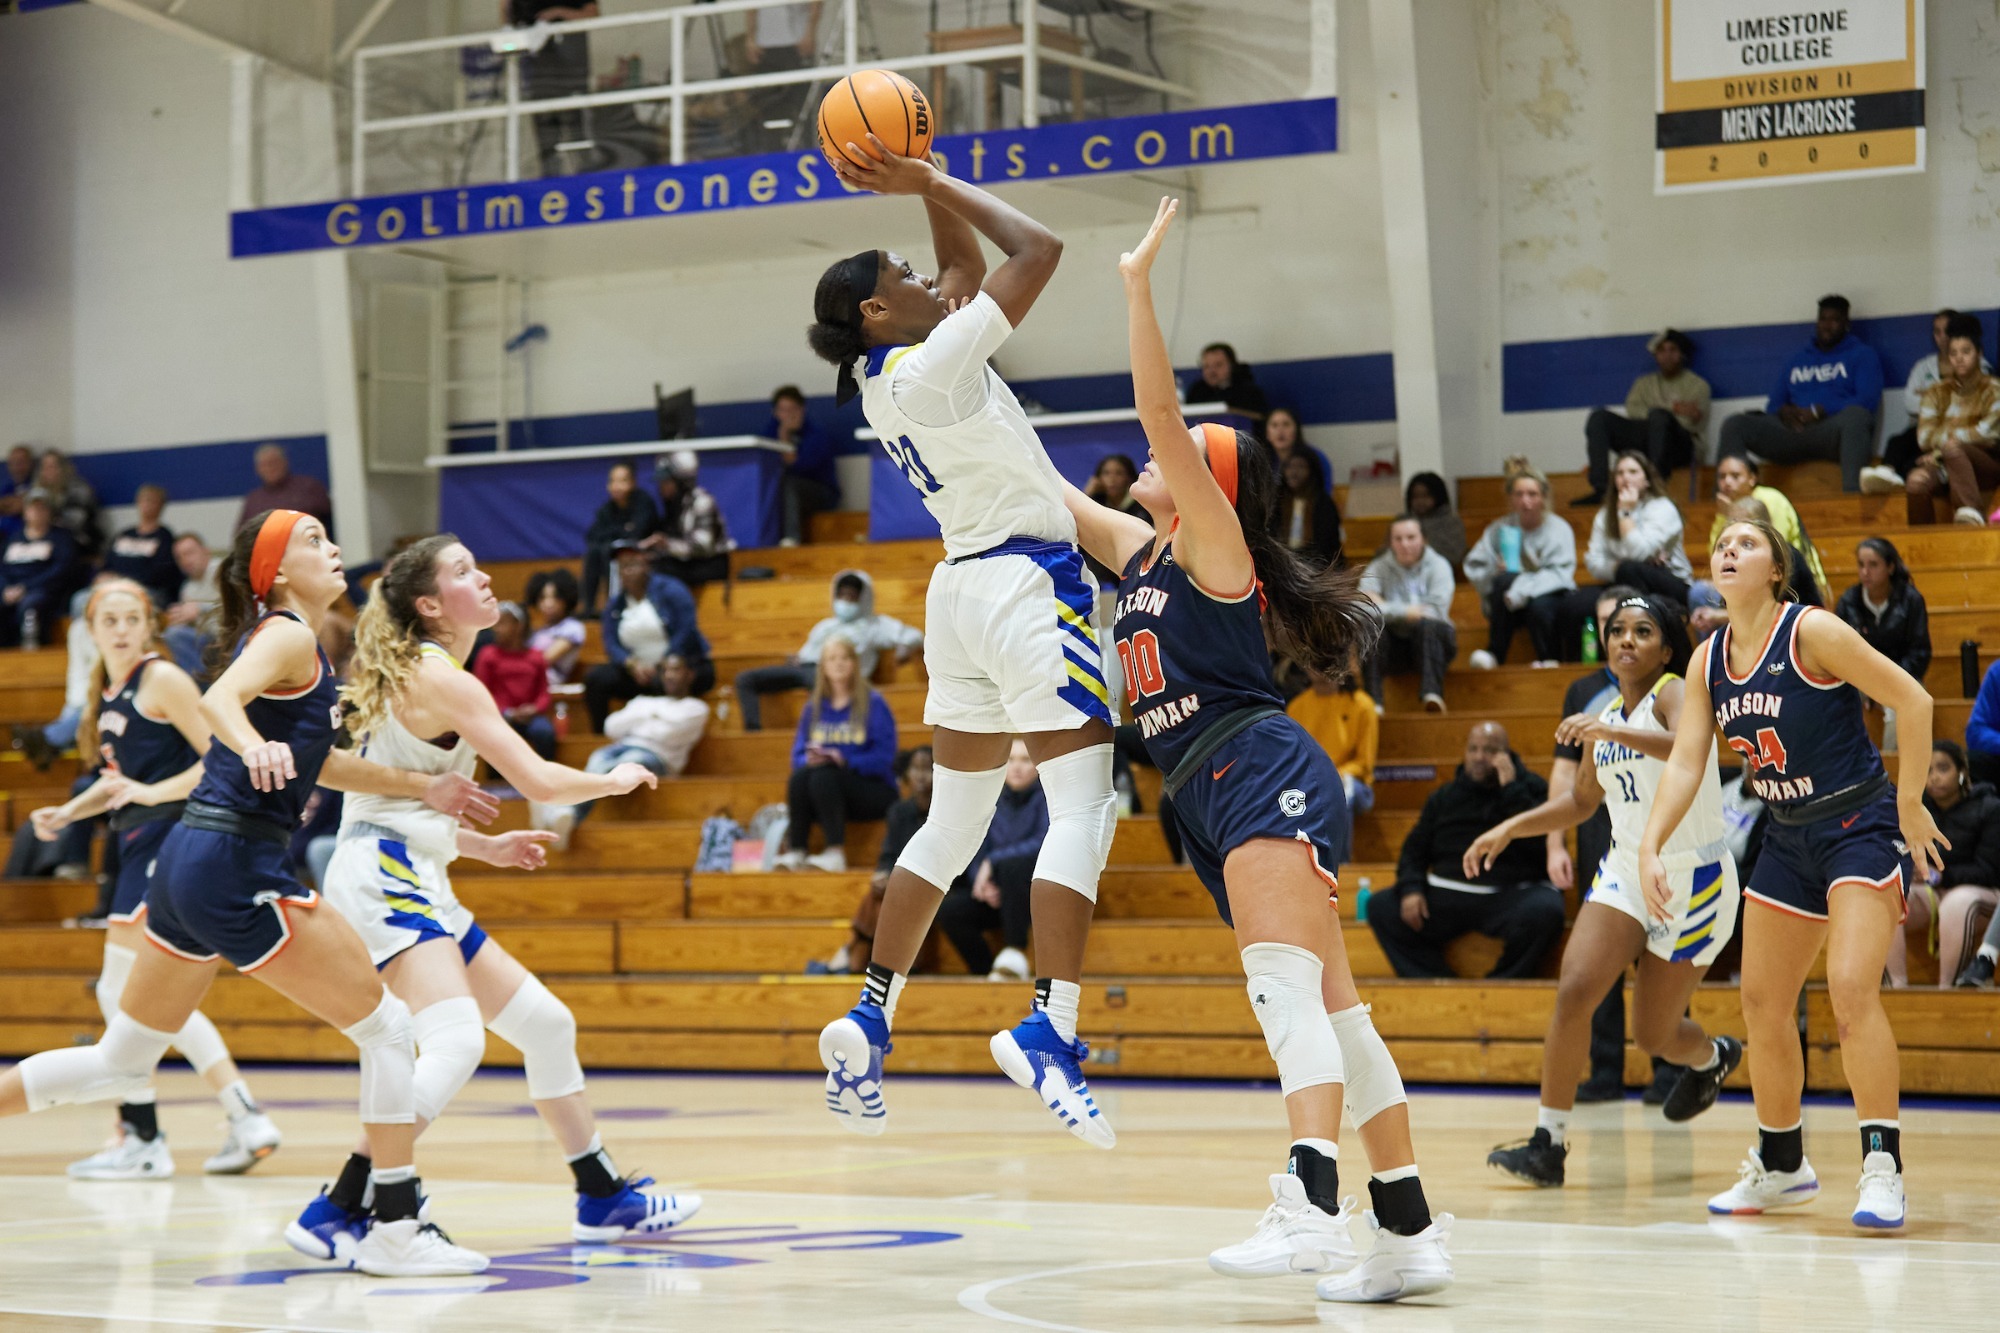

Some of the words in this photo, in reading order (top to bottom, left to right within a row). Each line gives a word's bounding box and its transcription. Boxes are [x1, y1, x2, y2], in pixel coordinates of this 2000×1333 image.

[1726, 9, 1848, 41] LIMESTONE
[1741, 37, 1833, 66] COLLEGE
[1725, 74, 1818, 99] DIVISION
[1838, 72, 1851, 88] II
[1722, 105, 1772, 142] MEN'S
[1774, 98, 1856, 137] LACROSSE
[326, 122, 1235, 245] GoLimestoneSts.com
[1791, 361, 1848, 384] NASA
[1114, 586, 1170, 626] ARSON
[1115, 628, 1167, 707] 00
[1615, 769, 1641, 802] 11
